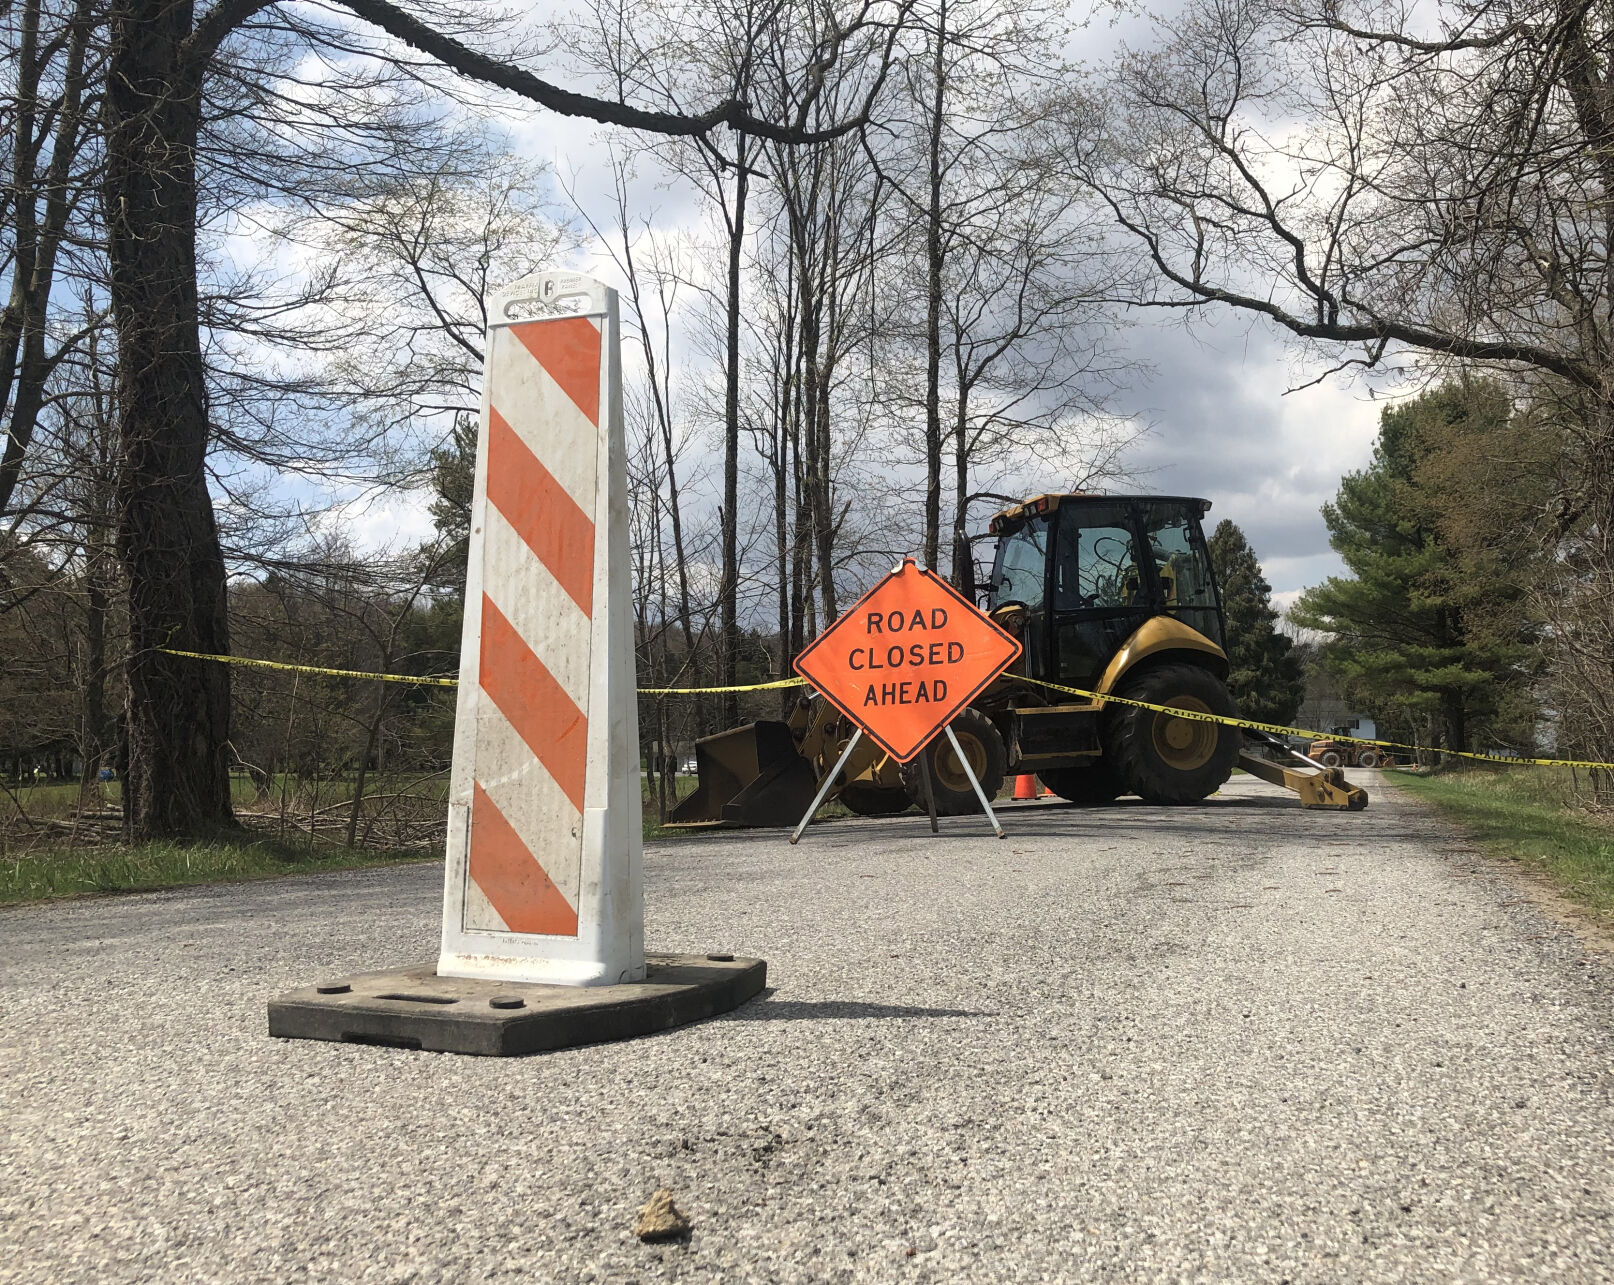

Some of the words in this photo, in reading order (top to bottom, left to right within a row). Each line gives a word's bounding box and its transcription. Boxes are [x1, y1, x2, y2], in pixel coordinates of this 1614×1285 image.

[867, 608, 948, 634] ROAD
[849, 642, 965, 671] CLOSED
[863, 679, 948, 707] AHEAD
[1162, 708, 1225, 726] CAUTION
[1236, 721, 1300, 736] CAUTION
